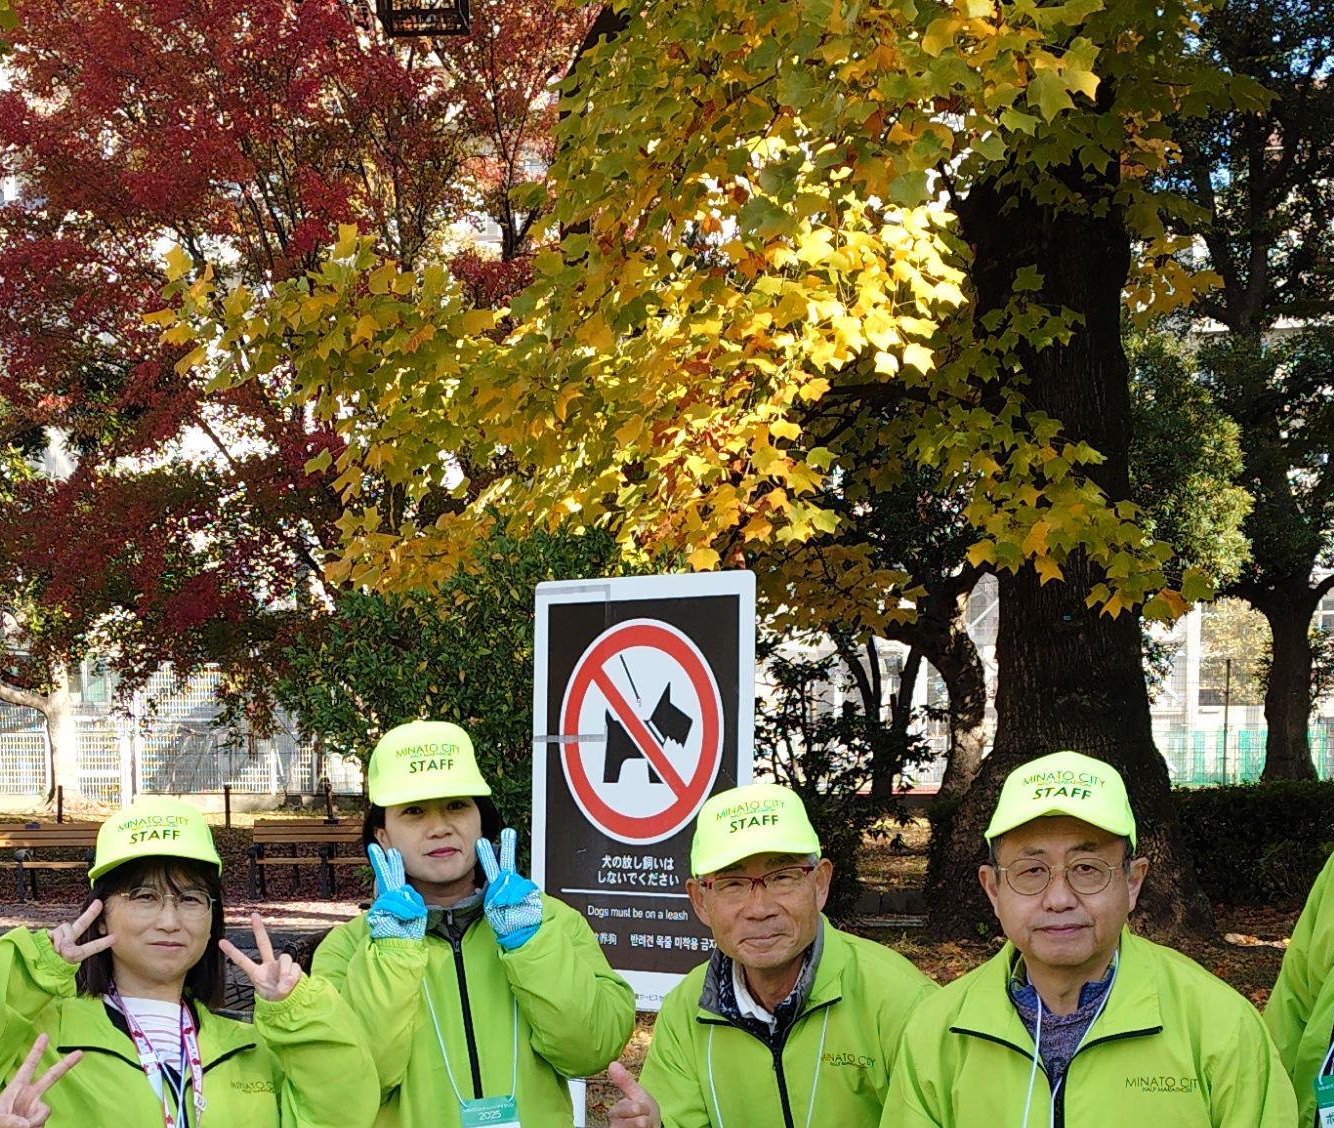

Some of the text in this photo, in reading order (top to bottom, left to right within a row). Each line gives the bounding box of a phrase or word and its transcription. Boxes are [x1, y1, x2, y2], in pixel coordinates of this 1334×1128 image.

[409, 759, 454, 774] STAFF
[1032, 787, 1092, 800] STAFF
[729, 815, 779, 834] STAFF
[129, 829, 180, 844] STAFF
[602, 855, 674, 870] 犬の放し飼いは
[598, 871, 679, 886] しないでください
[587, 905, 689, 921] Dogs must be on a leash
[630, 934, 654, 948] 반려견
[656, 935, 672, 949] 목줄
[674, 935, 699, 951] 미착용
[1125, 1076, 1176, 1088] MINATO
[478, 1110, 502, 1120] 2025
